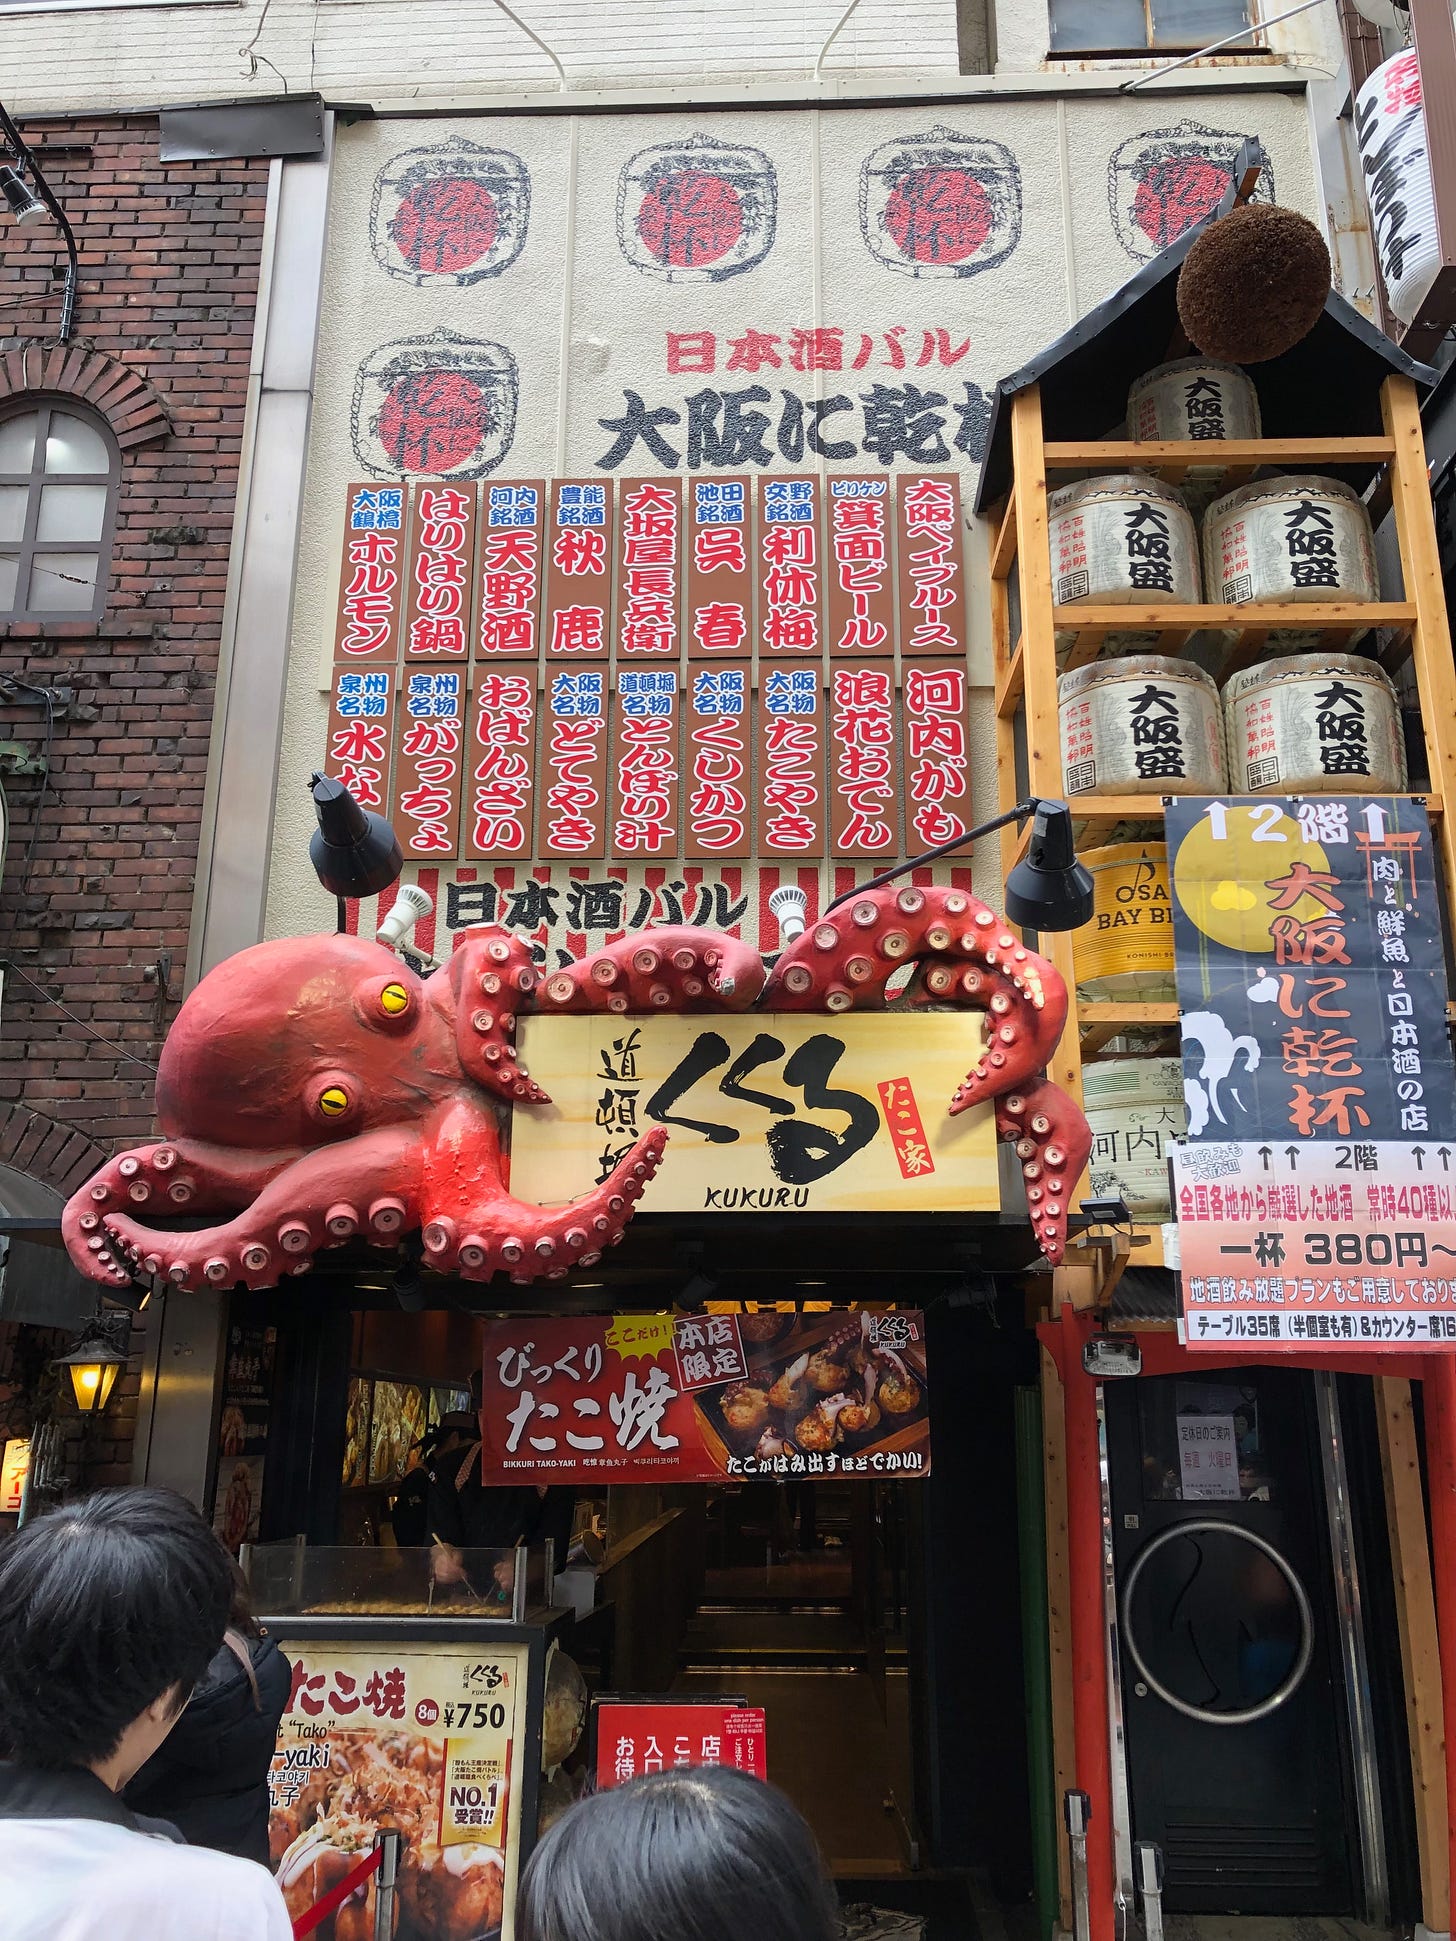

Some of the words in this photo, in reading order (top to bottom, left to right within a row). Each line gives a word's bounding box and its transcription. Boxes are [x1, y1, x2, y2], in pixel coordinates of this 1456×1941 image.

[666, 326, 971, 374] 日本酒バル
[1184, 377, 1226, 440] 大阪盛
[355, 490, 401, 508] 大阪
[489, 487, 537, 506] 河内
[559, 486, 604, 506] 豊能
[696, 483, 744, 502] 池田
[765, 481, 813, 501] 交野
[831, 481, 887, 497] ビリケン
[352, 509, 400, 529] 鶴橋
[489, 507, 536, 526] 銘酒
[558, 506, 604, 526] 銘酒
[696, 503, 744, 523] 銘酒
[765, 502, 813, 522] 銘酒
[1123, 503, 1174, 594] 大阪盛
[1284, 500, 1341, 589] 大阪盛
[409, 489, 470, 654] はりはり鍋
[622, 484, 676, 652] 大坂屋長兵衛
[834, 499, 887, 648] 箕面ビール
[904, 479, 958, 648] 大阪ベイブルース
[341, 532, 397, 655] ホルモン
[481, 530, 538, 652] 天野酒
[551, 529, 606, 653] 秋鹿
[694, 527, 747, 649] 呉春
[763, 525, 817, 649] 利休梅
[340, 674, 389, 695] 泉州
[409, 673, 459, 695] 泉州
[552, 673, 602, 694] 大阪
[620, 672, 676, 694] 道頓堀
[694, 671, 743, 693] 大阪
[766, 671, 816, 693] 大阪
[337, 696, 387, 716] 名物
[408, 696, 458, 716] 名物
[552, 695, 602, 717] 名物
[622, 695, 671, 716] 名物
[694, 694, 743, 715] 名物
[766, 694, 816, 715] 名物
[1128, 684, 1186, 780] 大阪盛
[1314, 682, 1371, 776] 大阪盛
[473, 675, 533, 852] おばんざい
[833, 671, 894, 849] 浪花おでん
[906, 669, 967, 848] 河内がも
[401, 719, 462, 852] がっちょ
[547, 719, 604, 852] どてやき
[615, 718, 678, 851] とんぼり汁
[690, 717, 746, 850] くしかつ
[764, 716, 818, 849] たこやき
[1248, 804, 1349, 844] 2階
[446, 880, 749, 930] 日本酒バル
[1097, 908, 1142, 930] BAY
[1264, 861, 1371, 1136] 大阪に乾杯
[1371, 856, 1429, 1131] 肉と鮮魚と日本酒の店
[644, 1031, 880, 1185] くくる
[882, 1080, 933, 1176] たこ家
[1089, 1125, 1187, 1165] 河内
[1180, 1143, 1243, 1168] 昼飲みも
[1335, 1145, 1378, 1171] 2階
[704, 1187, 810, 1209] KUKURU
[1180, 1184, 1353, 1221] 全国各地から厳選した地酒
[1367, 1184, 1456, 1221] 常時40種以
[1220, 1232, 1286, 1268] 一杯
[680, 1316, 733, 1350] 本店
[497, 1342, 602, 1388] びっくり
[681, 1348, 741, 1383] 限定
[505, 1366, 679, 1453] たこ焼
[1181, 1425, 1231, 1441] 定休日のご案内
[503, 1460, 534, 1468] BIKKURI
[536, 1459, 576, 1467] TAKO-YAKI
[1209, 1451, 1231, 1468] 火曜日
[418, 1704, 437, 1721] 8個
[444, 1703, 505, 1728] ¥750
[615, 1736, 635, 1784] お待
[450, 1783, 497, 1806] NO.1
